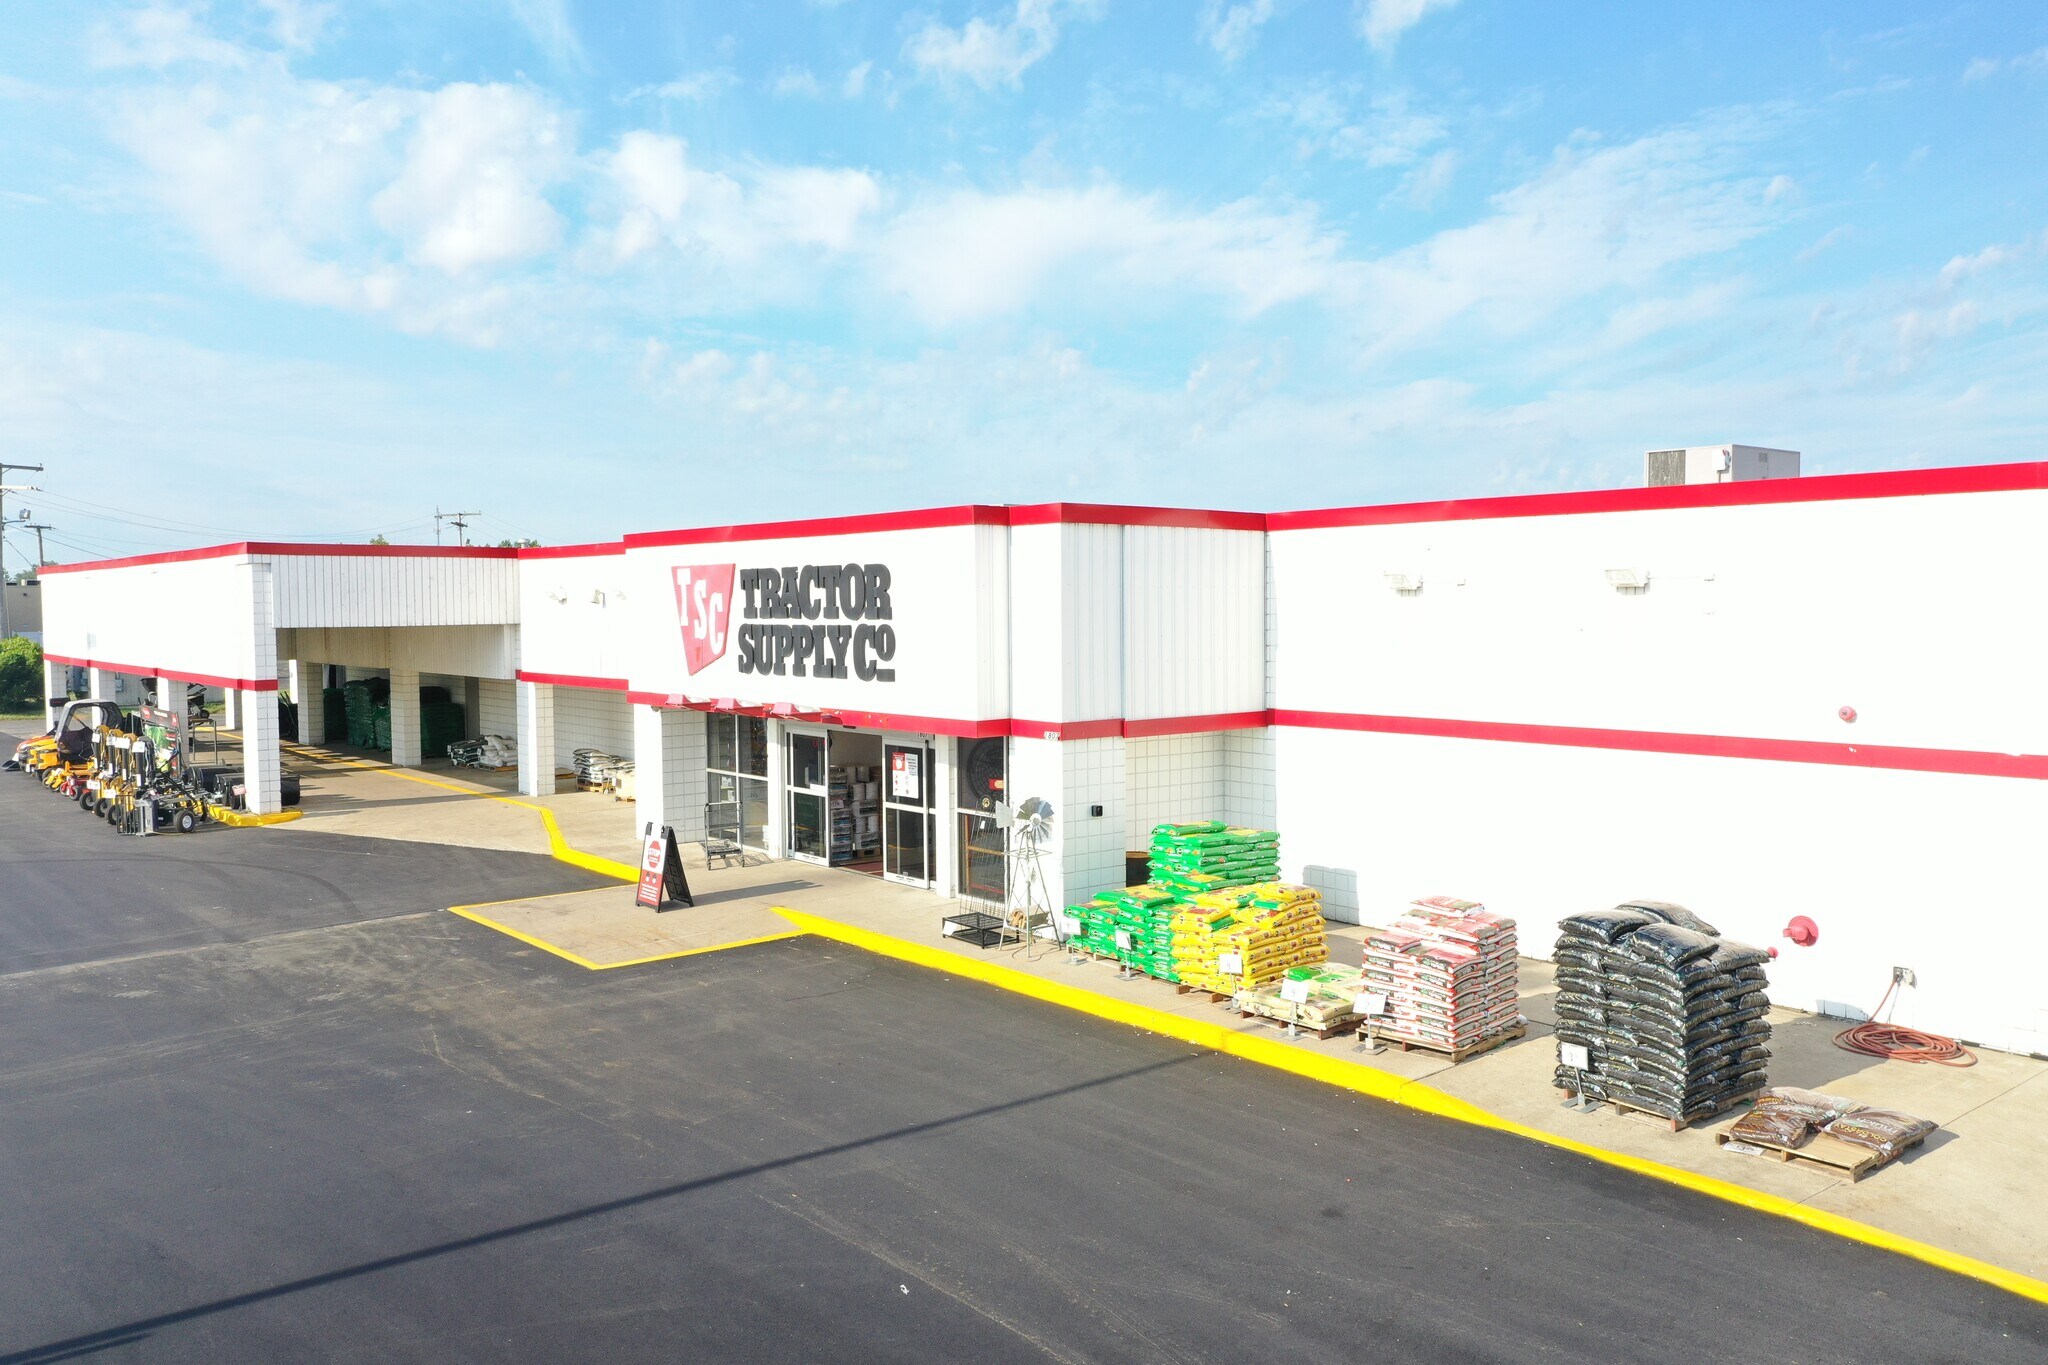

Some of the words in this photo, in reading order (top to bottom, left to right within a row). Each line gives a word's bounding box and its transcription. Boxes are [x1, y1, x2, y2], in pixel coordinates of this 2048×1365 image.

[676, 567, 724, 656] TSC
[740, 563, 893, 621] TRACTOR
[738, 623, 852, 679] SUPPLY
